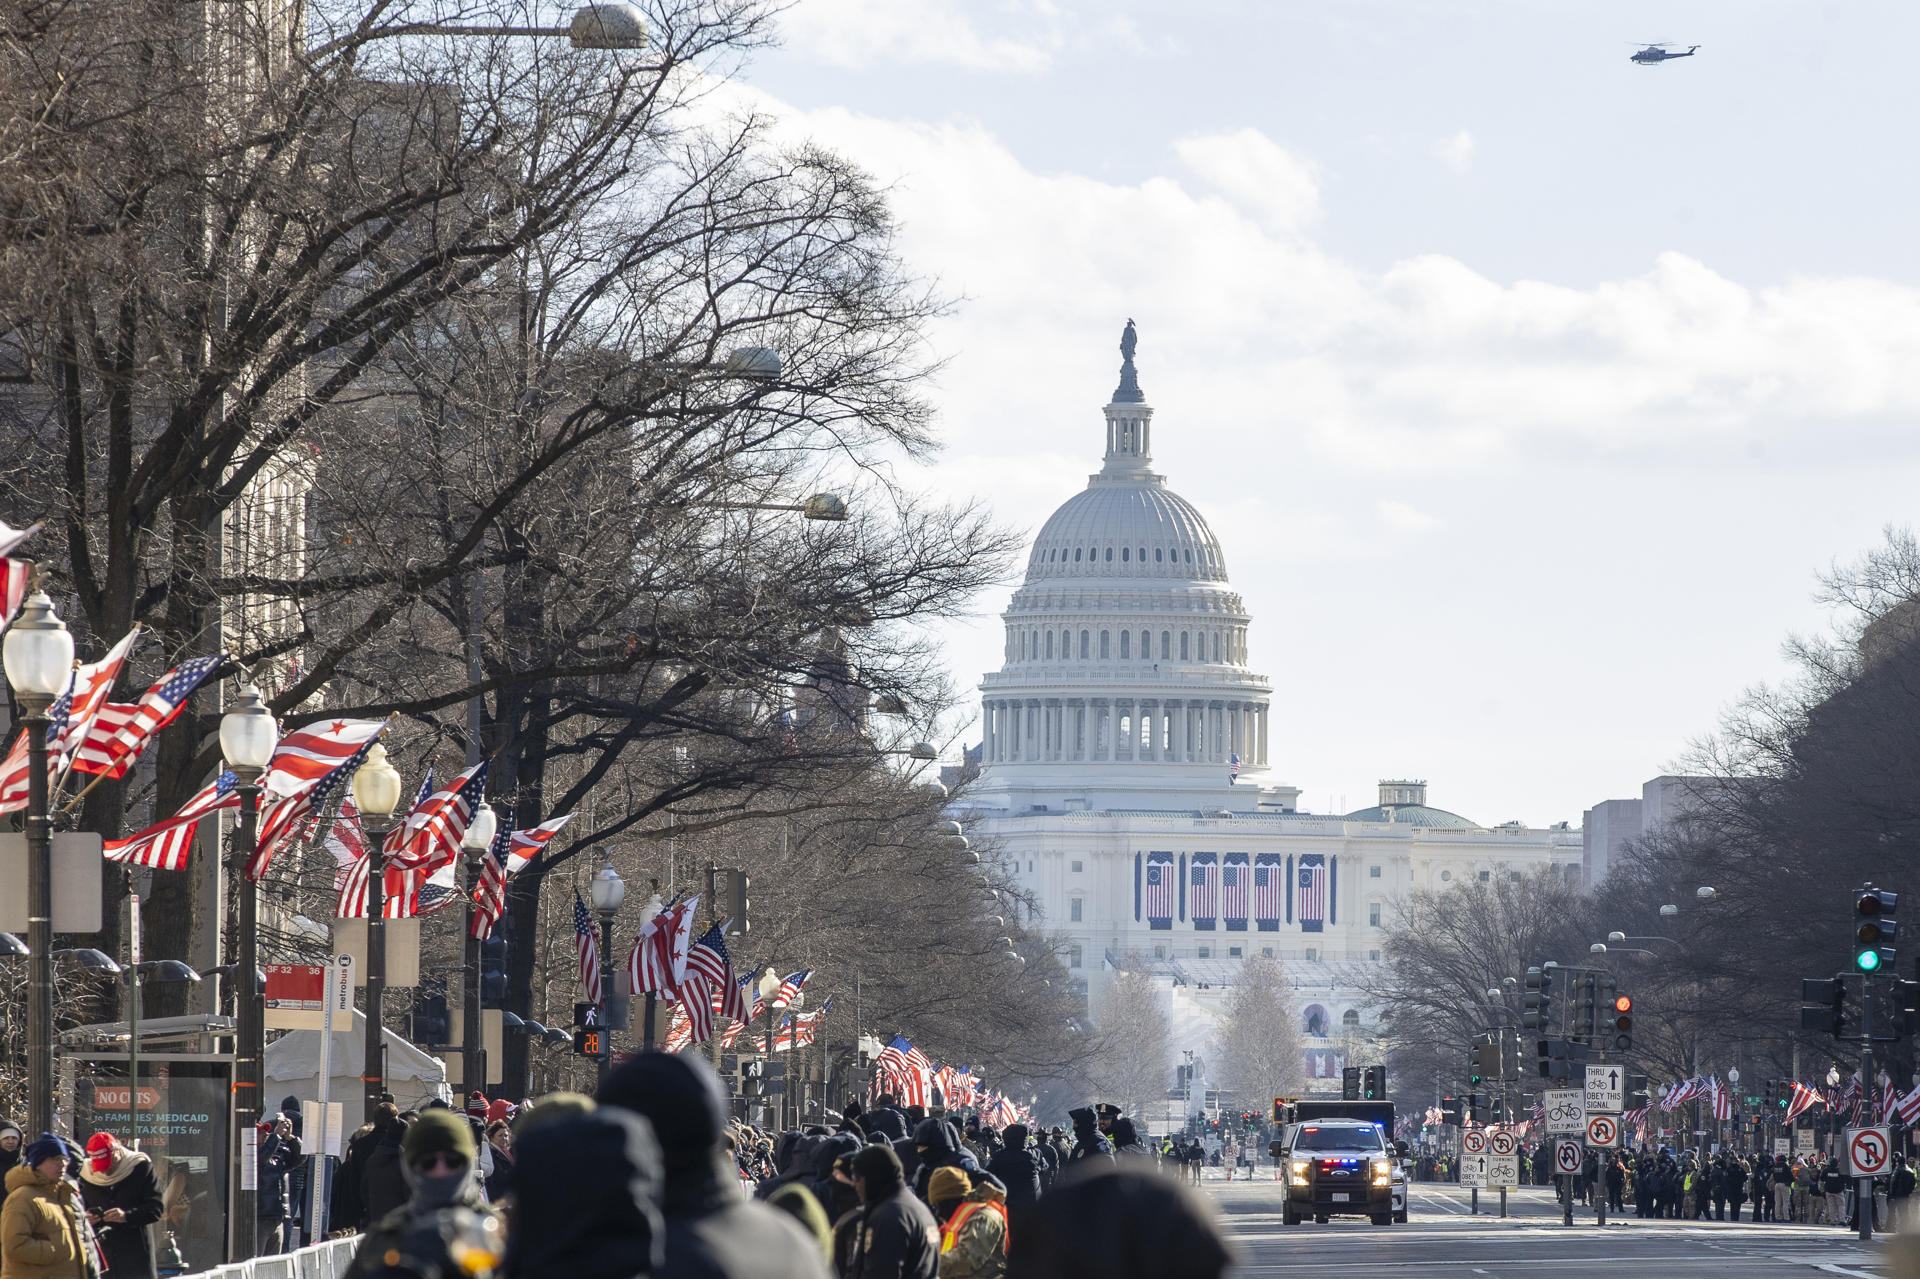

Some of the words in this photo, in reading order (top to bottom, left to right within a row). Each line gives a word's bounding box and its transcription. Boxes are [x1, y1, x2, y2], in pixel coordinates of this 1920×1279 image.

[280, 966, 292, 974] 32
[308, 967, 320, 975] 36
[339, 968, 348, 1010] metrobus
[584, 1034, 599, 1054] 28
[1587, 1068, 1605, 1076] THRU
[99, 1092, 117, 1104] NO
[1586, 1092, 1604, 1100] OBEY
[1607, 1092, 1622, 1100] THIS
[1586, 1101, 1609, 1109] SIGNAL
[105, 1114, 154, 1122] FAMIIES'
[156, 1114, 208, 1122] MEDICAID
[122, 1126, 131, 1134] fo
[136, 1126, 157, 1134] TAX
[159, 1125, 187, 1135] CUTS
[189, 1126, 201, 1135] for
